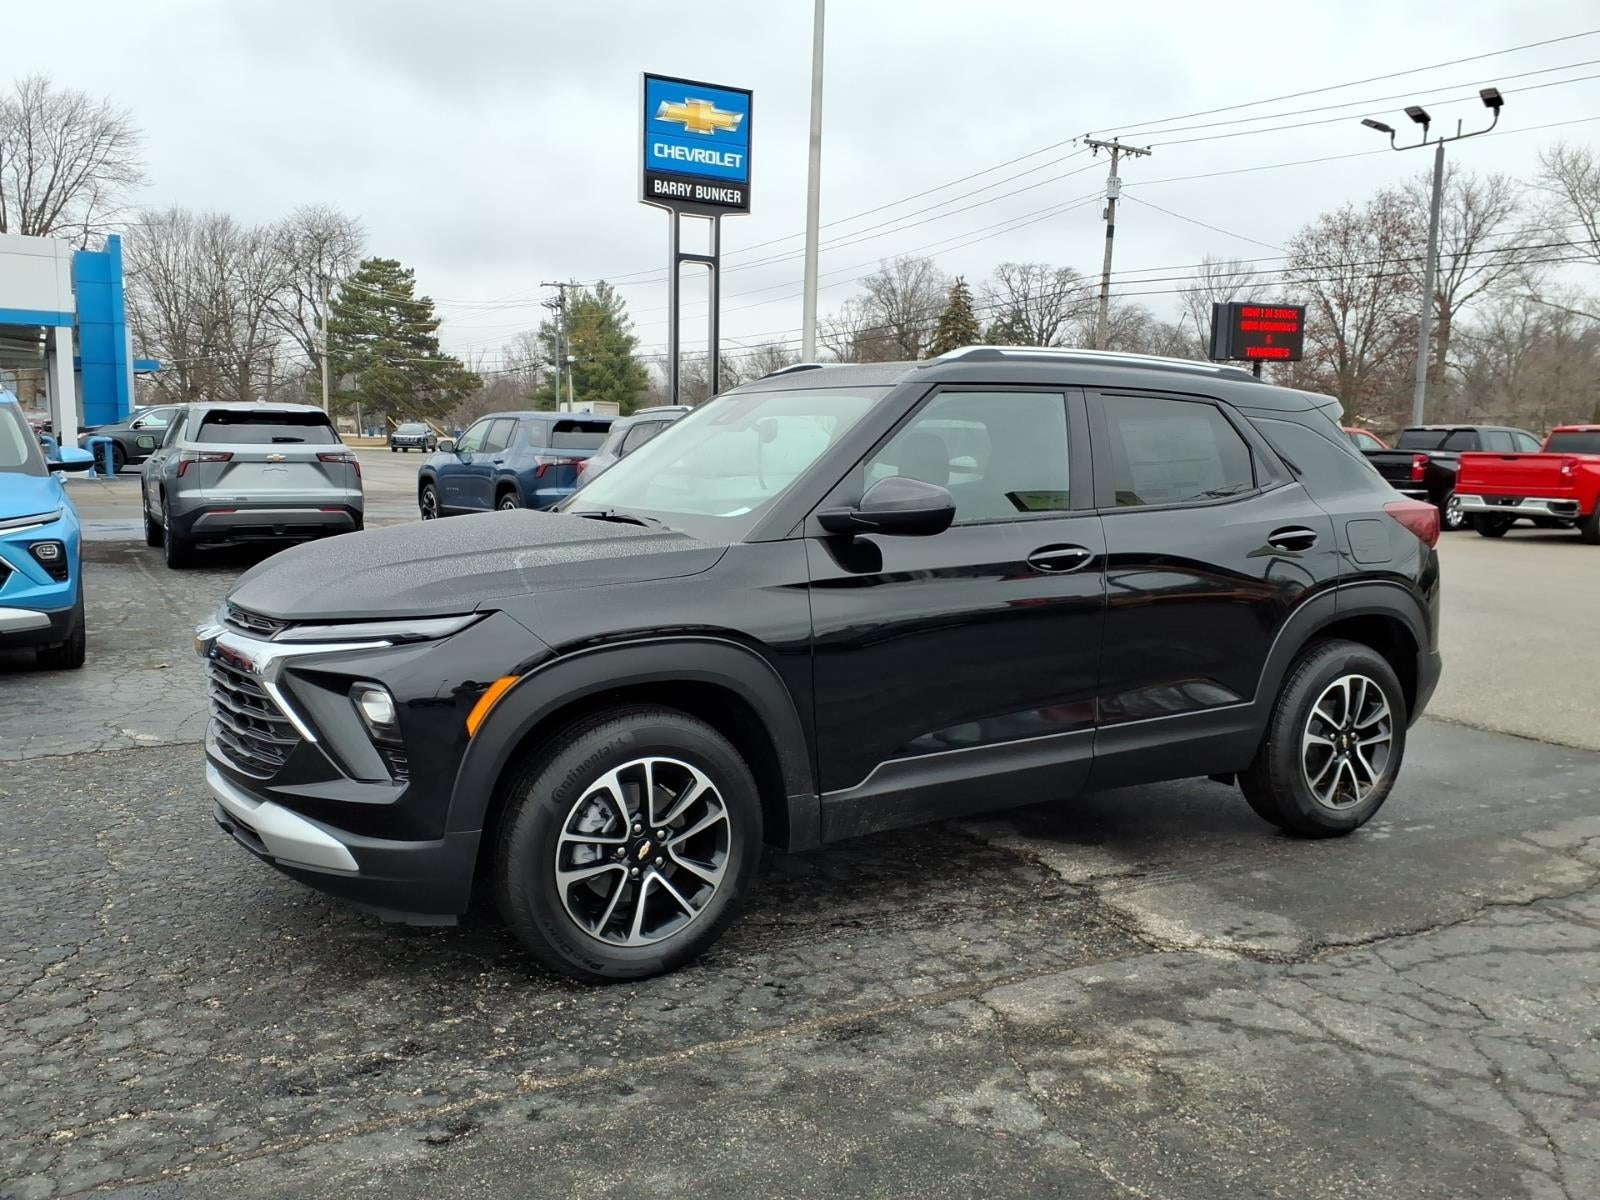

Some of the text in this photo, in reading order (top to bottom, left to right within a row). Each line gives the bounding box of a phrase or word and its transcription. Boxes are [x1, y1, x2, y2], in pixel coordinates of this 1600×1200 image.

[653, 142, 743, 168] CHEVROLET
[654, 179, 741, 203] BARRY BUNKER
